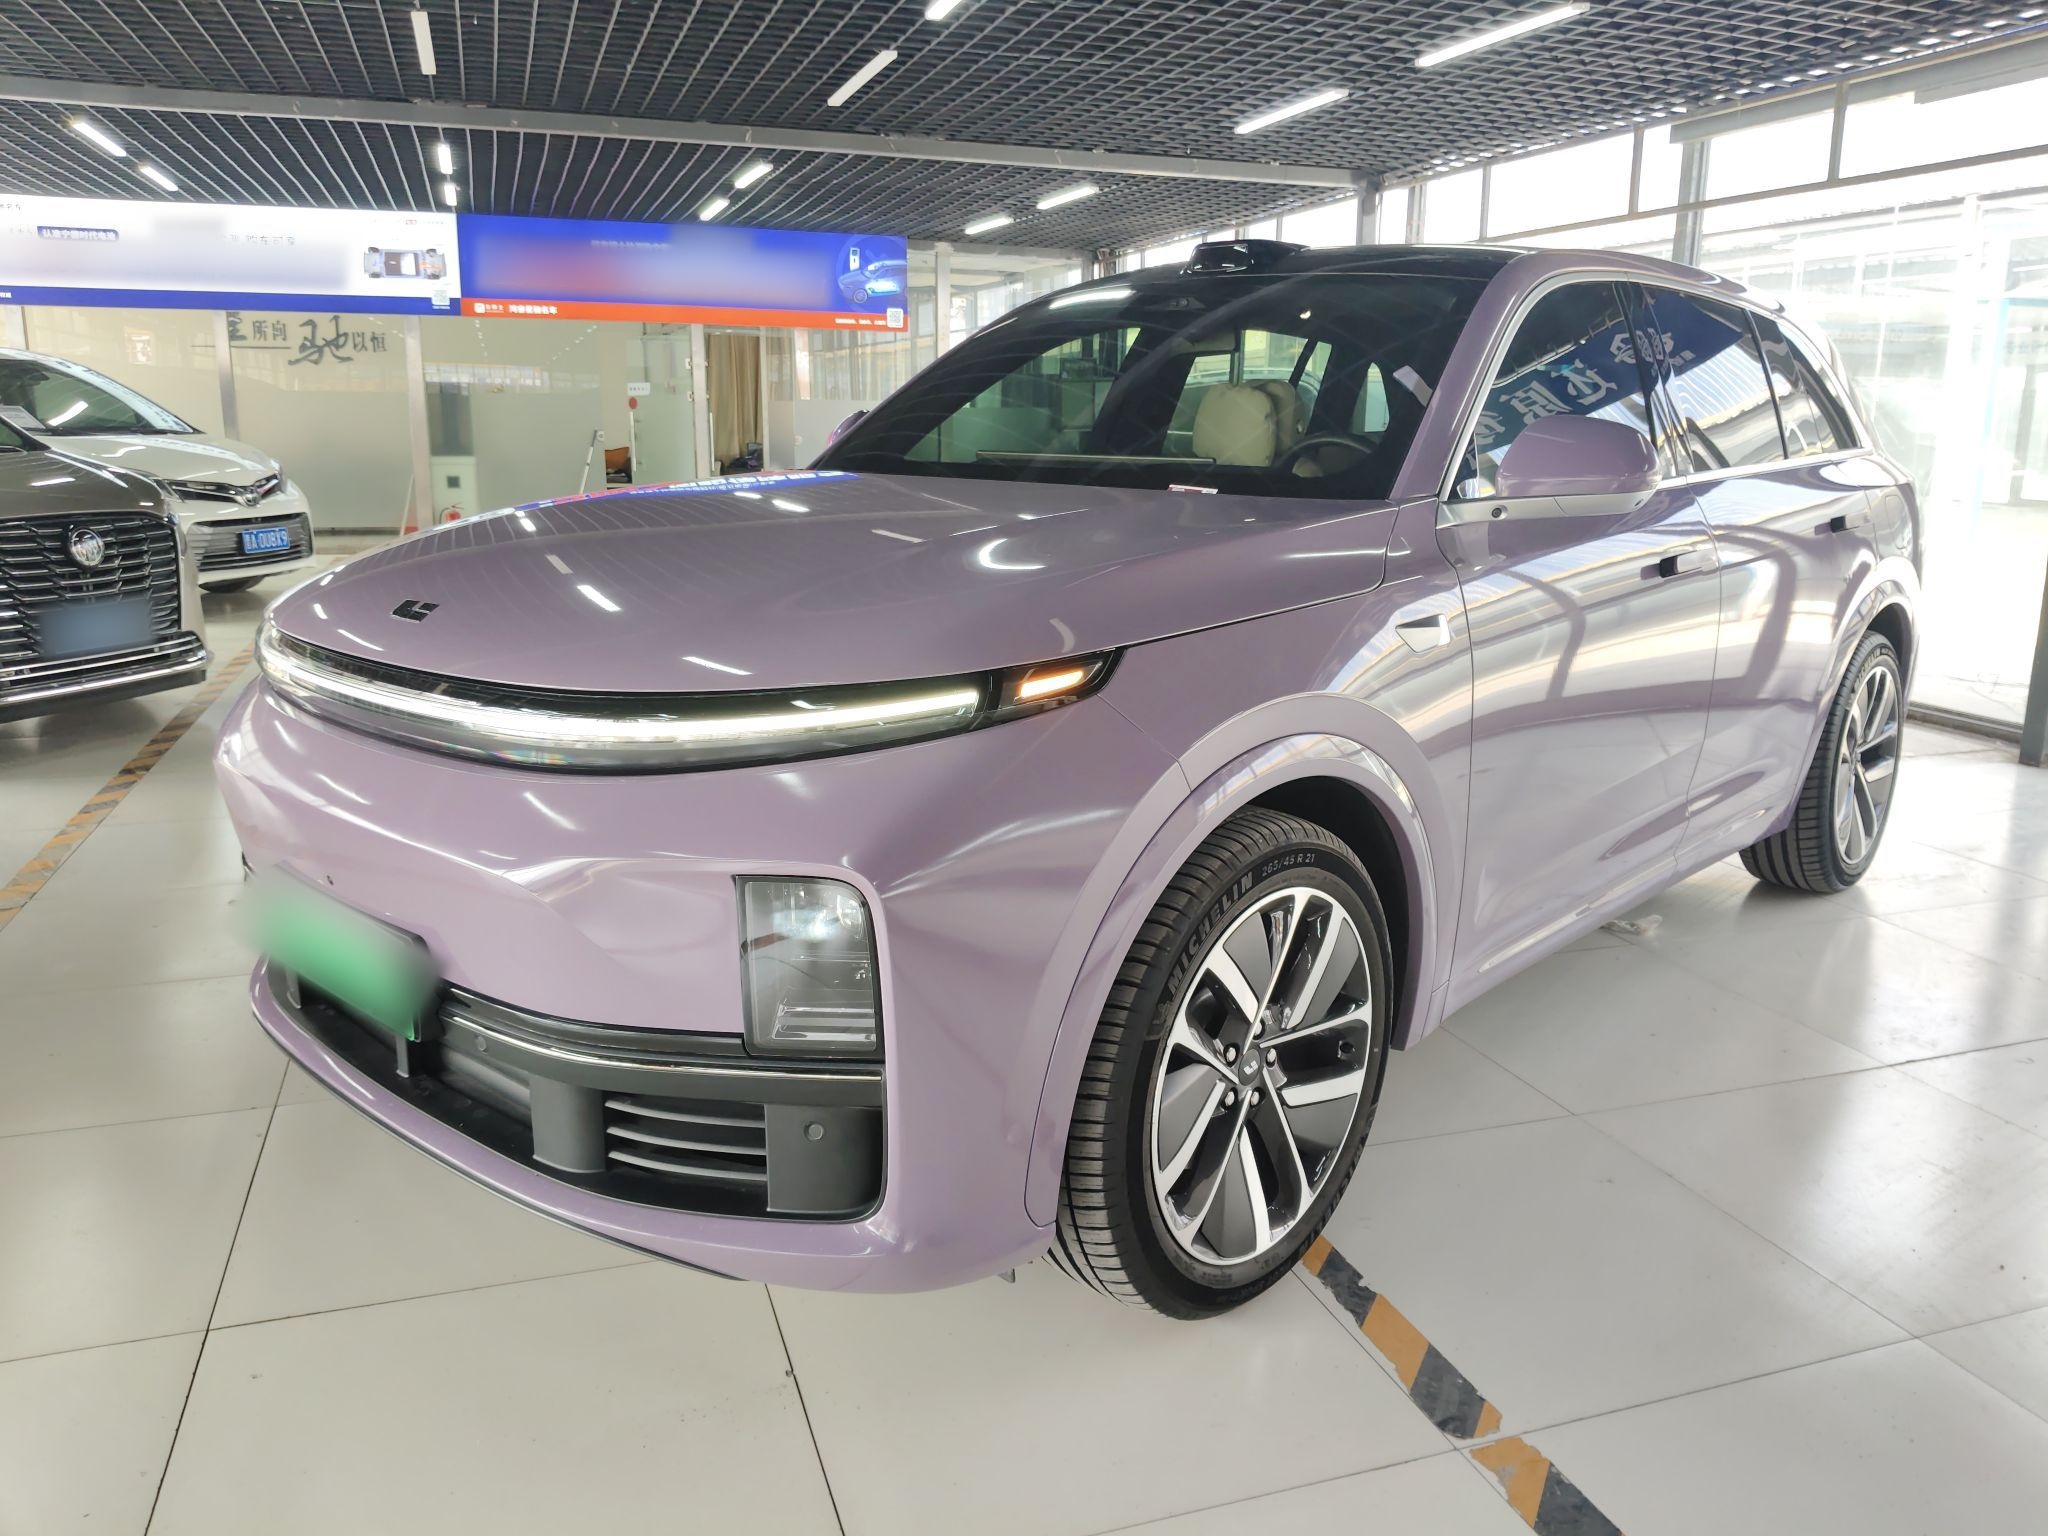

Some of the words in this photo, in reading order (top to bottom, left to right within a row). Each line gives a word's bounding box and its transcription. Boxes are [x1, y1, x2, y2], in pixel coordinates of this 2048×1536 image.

[1261, 854, 1296, 877] 265/45
[1297, 854, 1305, 865] R
[1305, 853, 1315, 864] 21
[1167, 871, 1254, 997] MICHELIN
